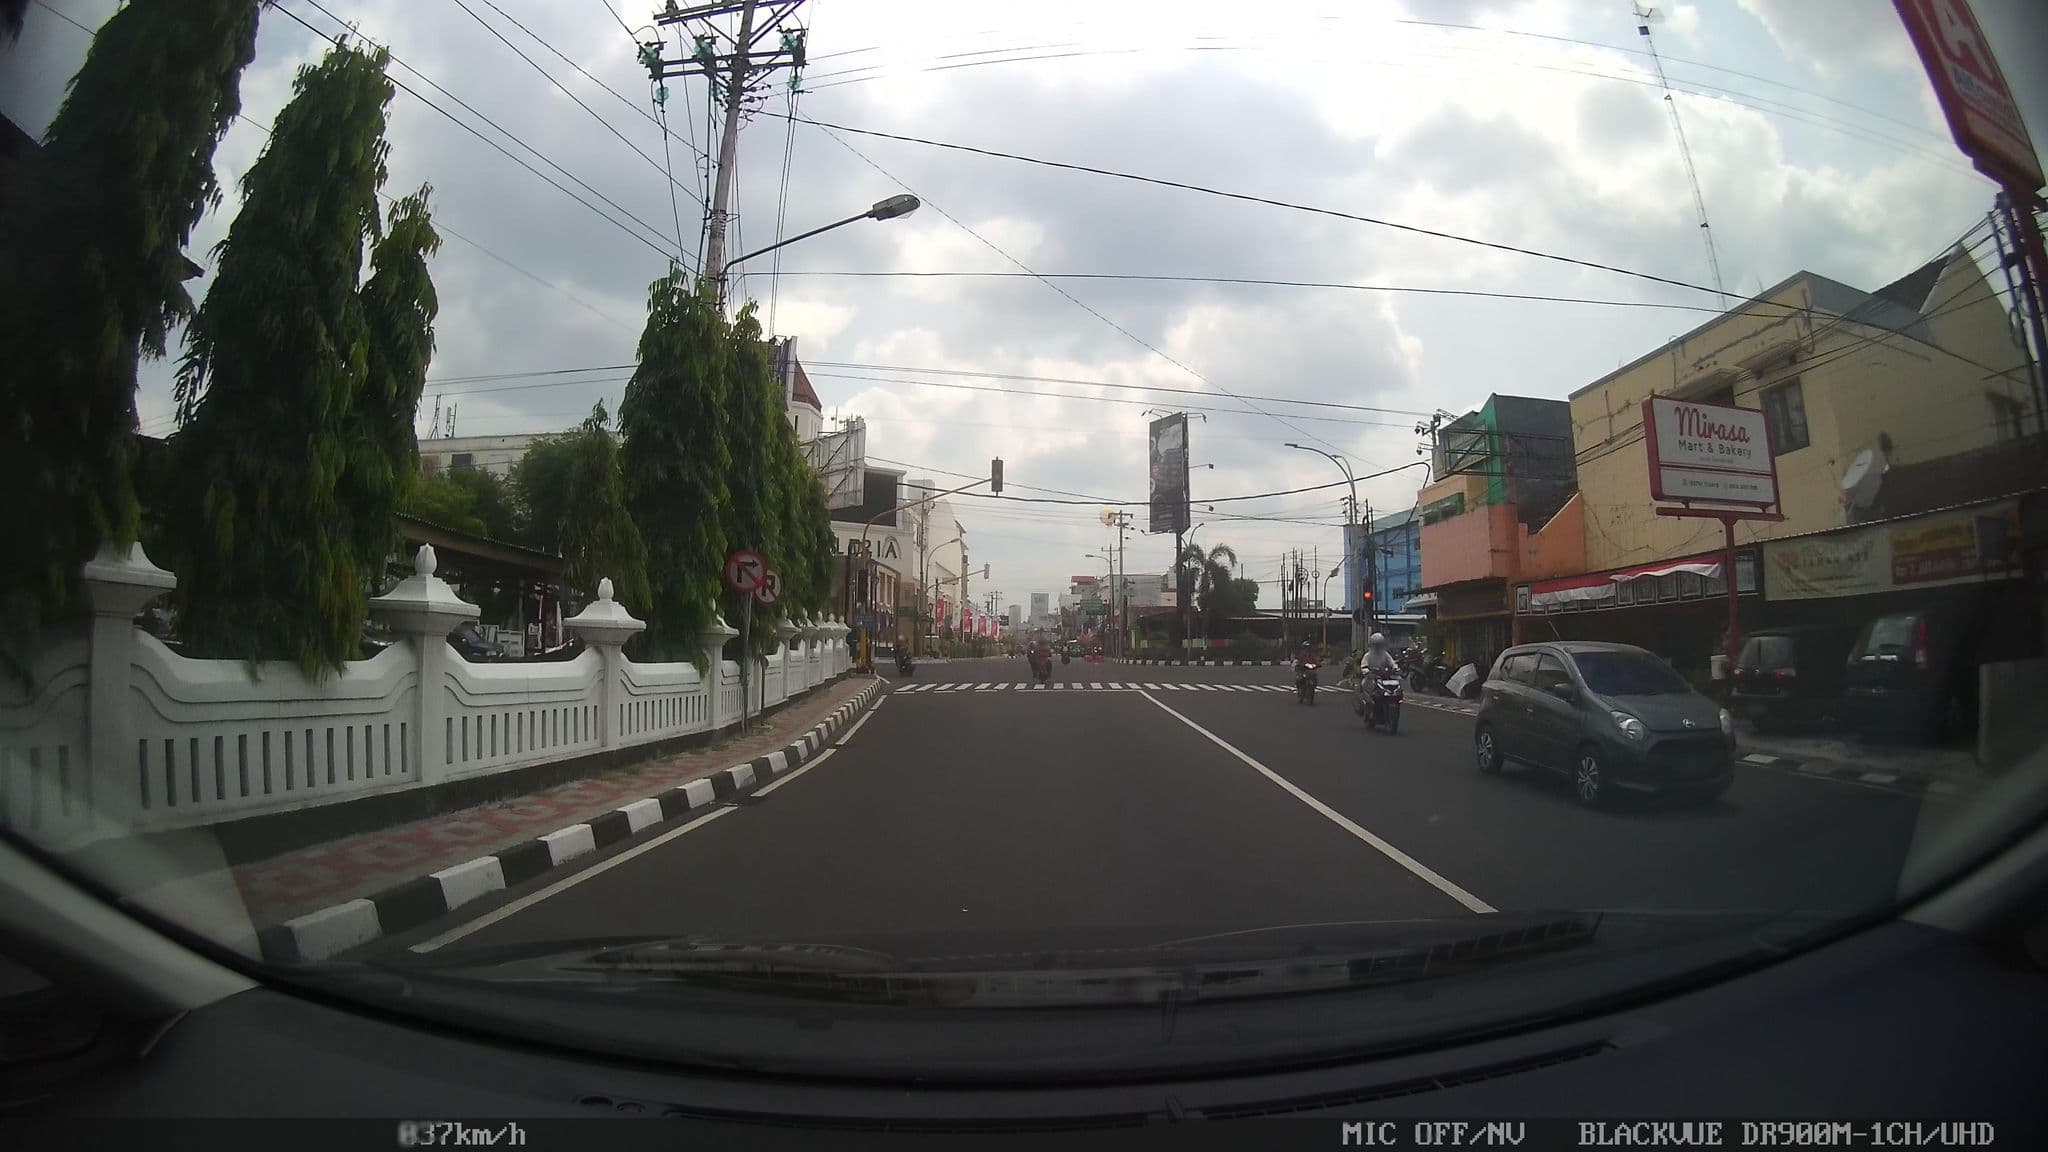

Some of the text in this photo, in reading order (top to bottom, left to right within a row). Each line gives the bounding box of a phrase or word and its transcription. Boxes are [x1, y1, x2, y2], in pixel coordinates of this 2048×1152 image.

[1674, 406, 1751, 444] Mirasa
[1678, 439, 1753, 459] Mart & Bakery
